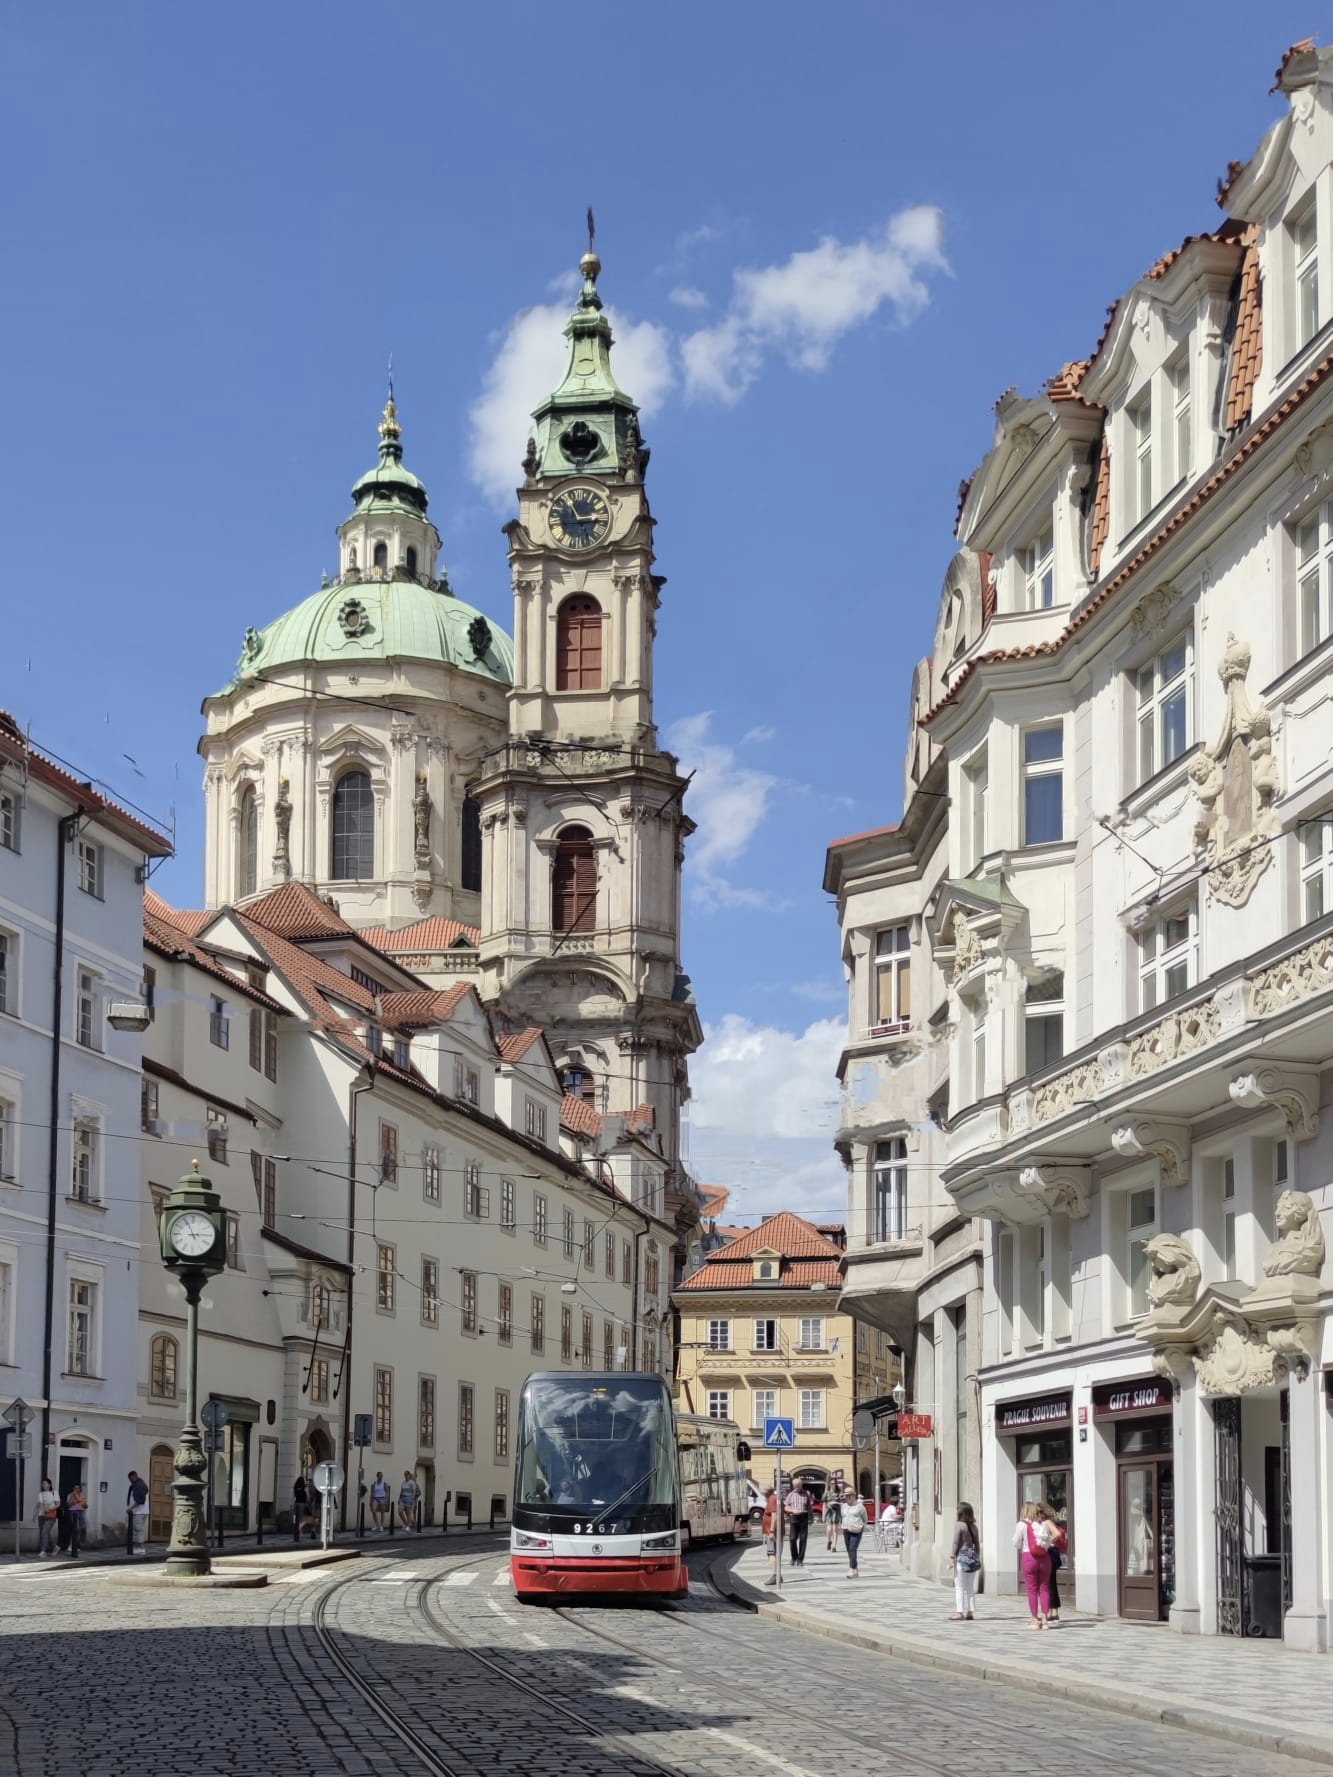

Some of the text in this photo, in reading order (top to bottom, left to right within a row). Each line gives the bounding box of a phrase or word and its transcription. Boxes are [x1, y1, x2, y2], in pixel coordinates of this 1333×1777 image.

[1109, 1388, 1159, 1410] GIFT SHOP
[902, 1415, 928, 1425] ART
[1003, 1408, 1030, 1426] PRAGUE
[1032, 1402, 1067, 1421] SOUVENIR
[574, 1523, 618, 1534] 9267
